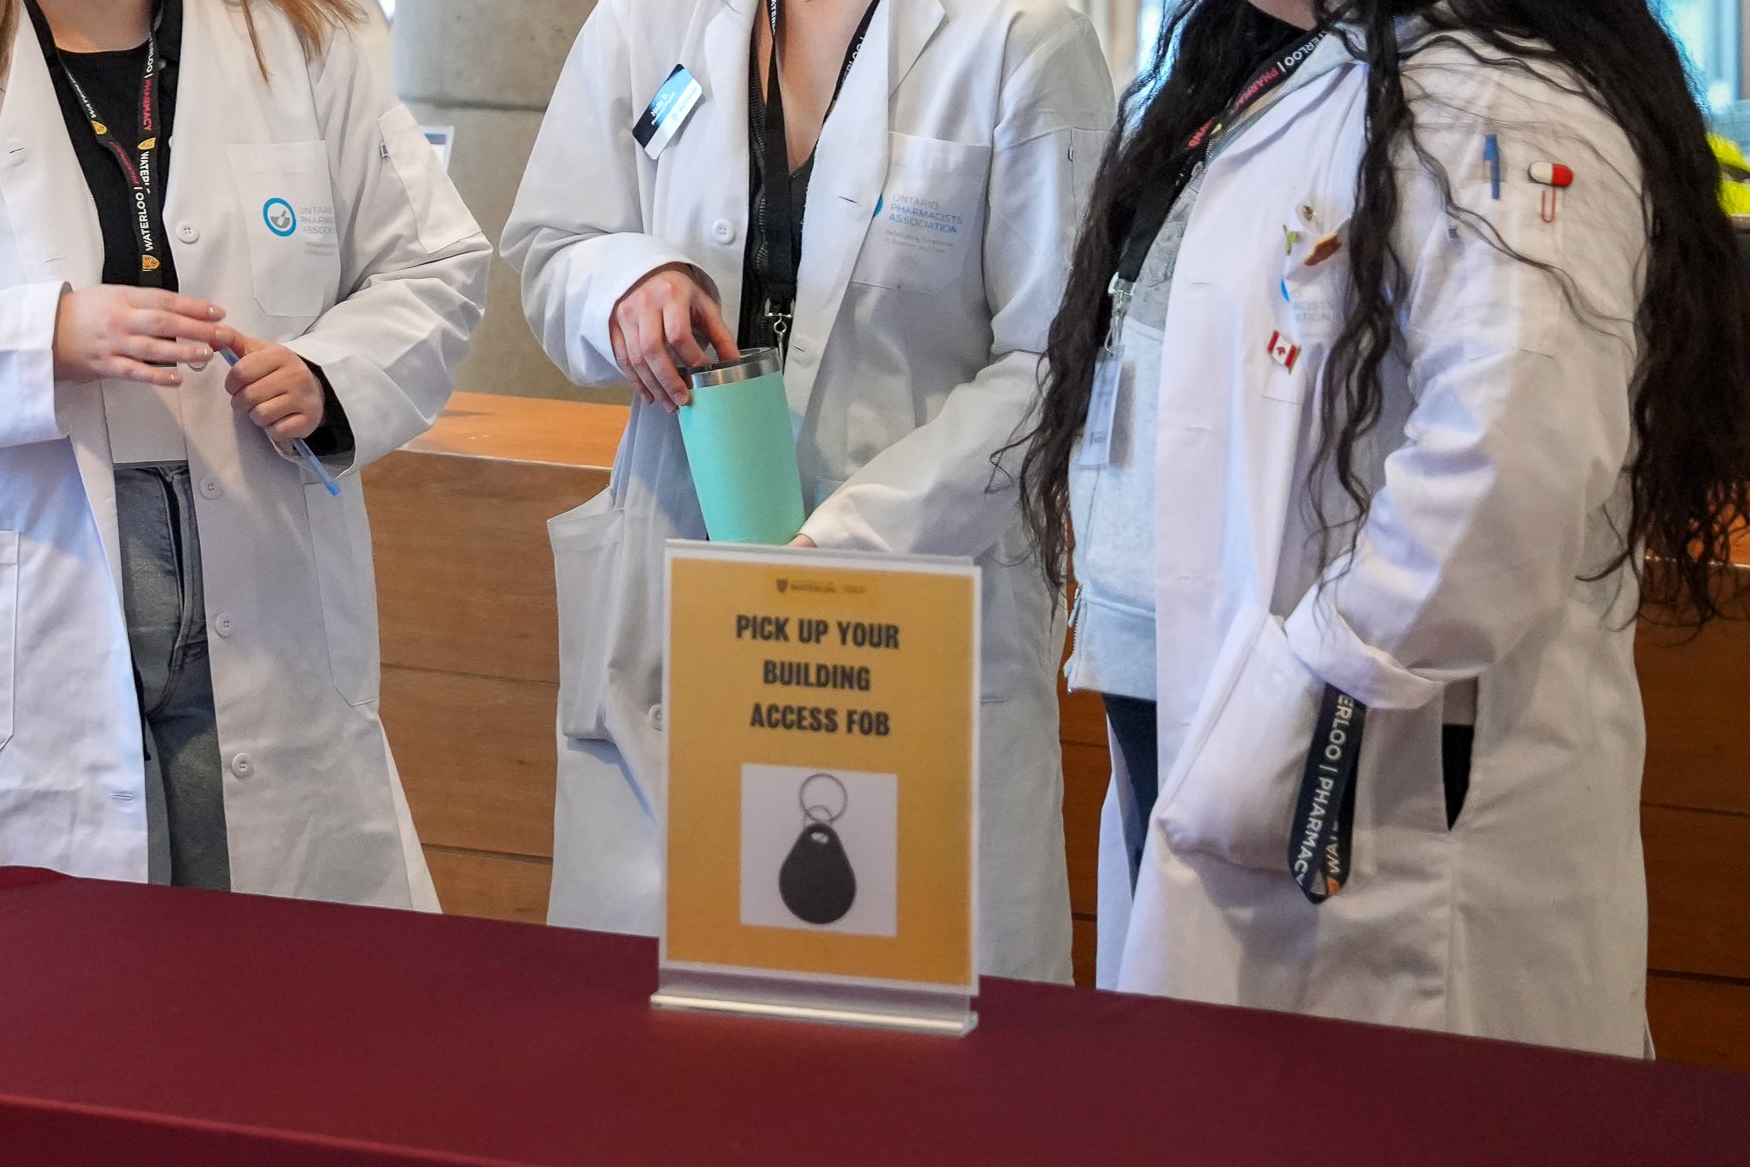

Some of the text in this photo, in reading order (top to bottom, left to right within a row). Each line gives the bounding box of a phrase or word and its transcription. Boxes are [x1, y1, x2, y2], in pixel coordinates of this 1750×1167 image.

[1284, 30, 1331, 67] TERLOO
[143, 78, 153, 131] PHARMACY
[890, 203, 963, 225] PHARMACISTS
[892, 194, 939, 210] ONTARIO
[135, 192, 154, 251] WATERLOO
[889, 213, 957, 234] ASSOCIATION
[736, 614, 900, 649] PICK UP YOUR
[763, 659, 871, 691] BUILDING
[751, 702, 891, 736] ACCESS FOB
